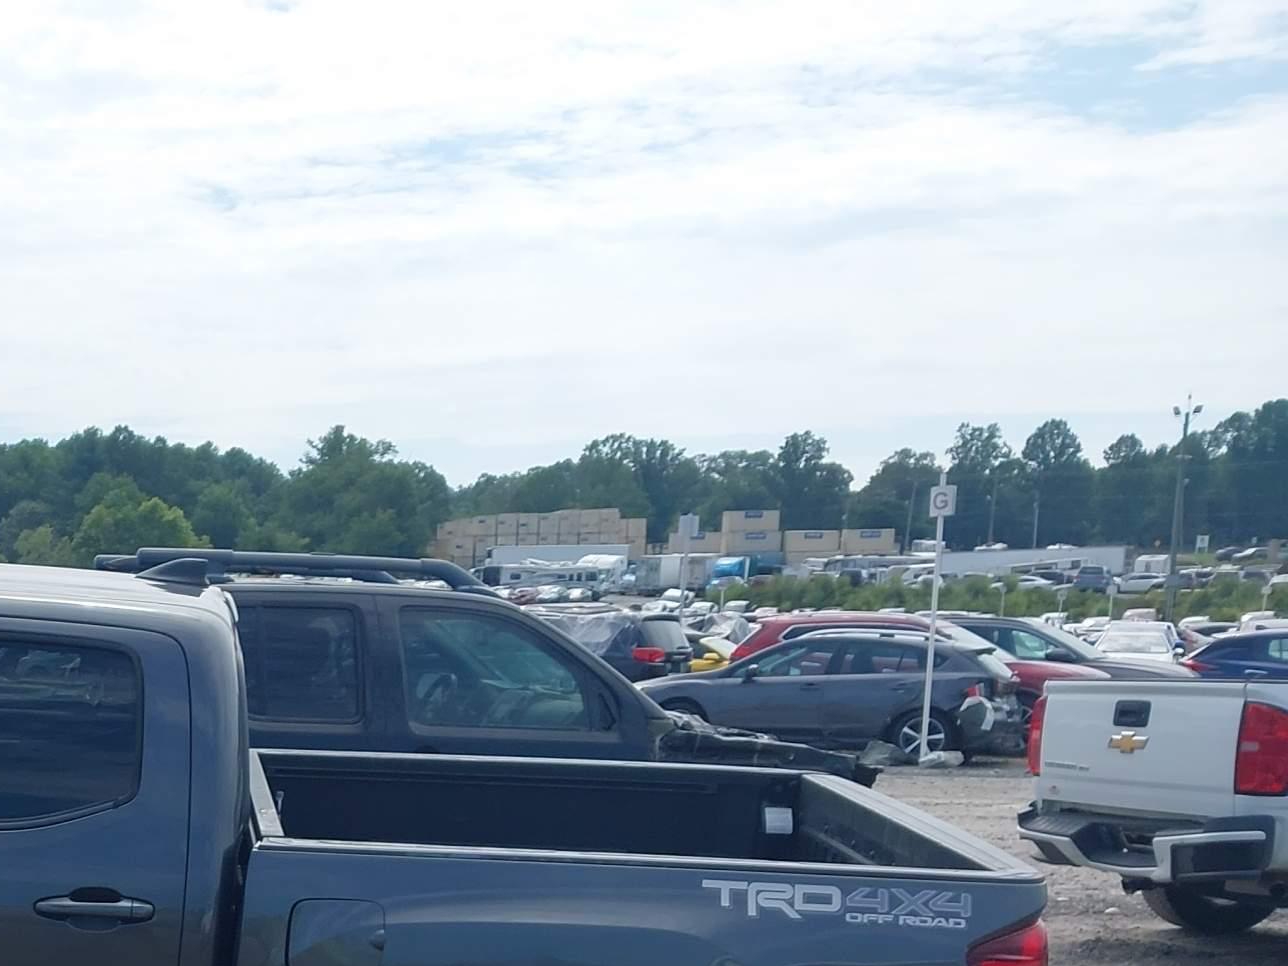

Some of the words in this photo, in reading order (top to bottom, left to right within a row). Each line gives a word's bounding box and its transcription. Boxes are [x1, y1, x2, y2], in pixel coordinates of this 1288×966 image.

[933, 492, 949, 510] G
[702, 879, 842, 919] TRD
[845, 912, 895, 924] OFF
[898, 915, 967, 929] ROAD
